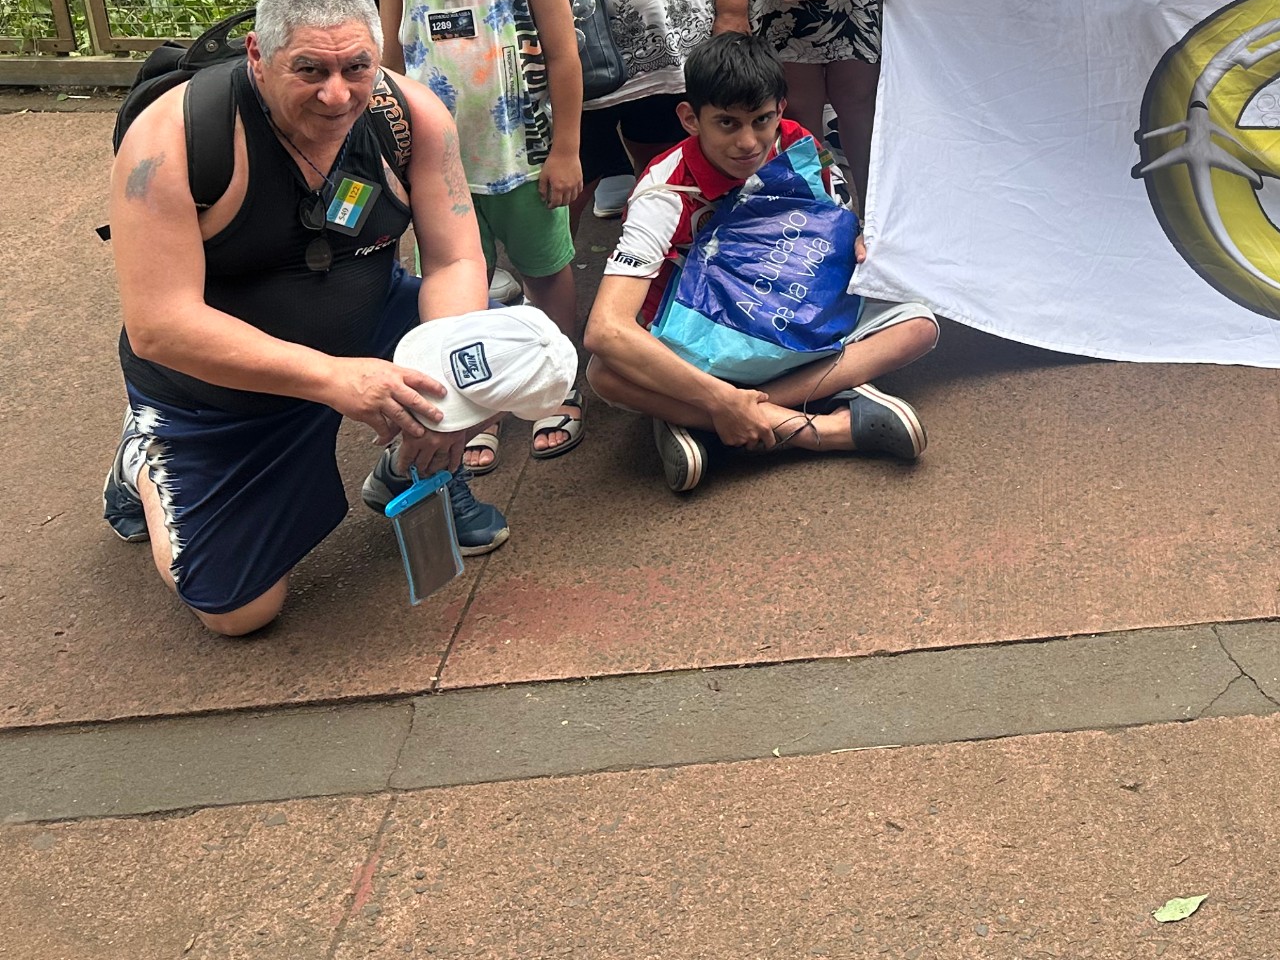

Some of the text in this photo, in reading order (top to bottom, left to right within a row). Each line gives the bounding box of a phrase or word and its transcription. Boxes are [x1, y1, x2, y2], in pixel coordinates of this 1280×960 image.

[431, 20, 452, 31] 1289
[736, 291, 763, 321] Al
[753, 212, 808, 296] cuidado
[769, 237, 832, 332] de la vida
[467, 354, 479, 372] NIKE
